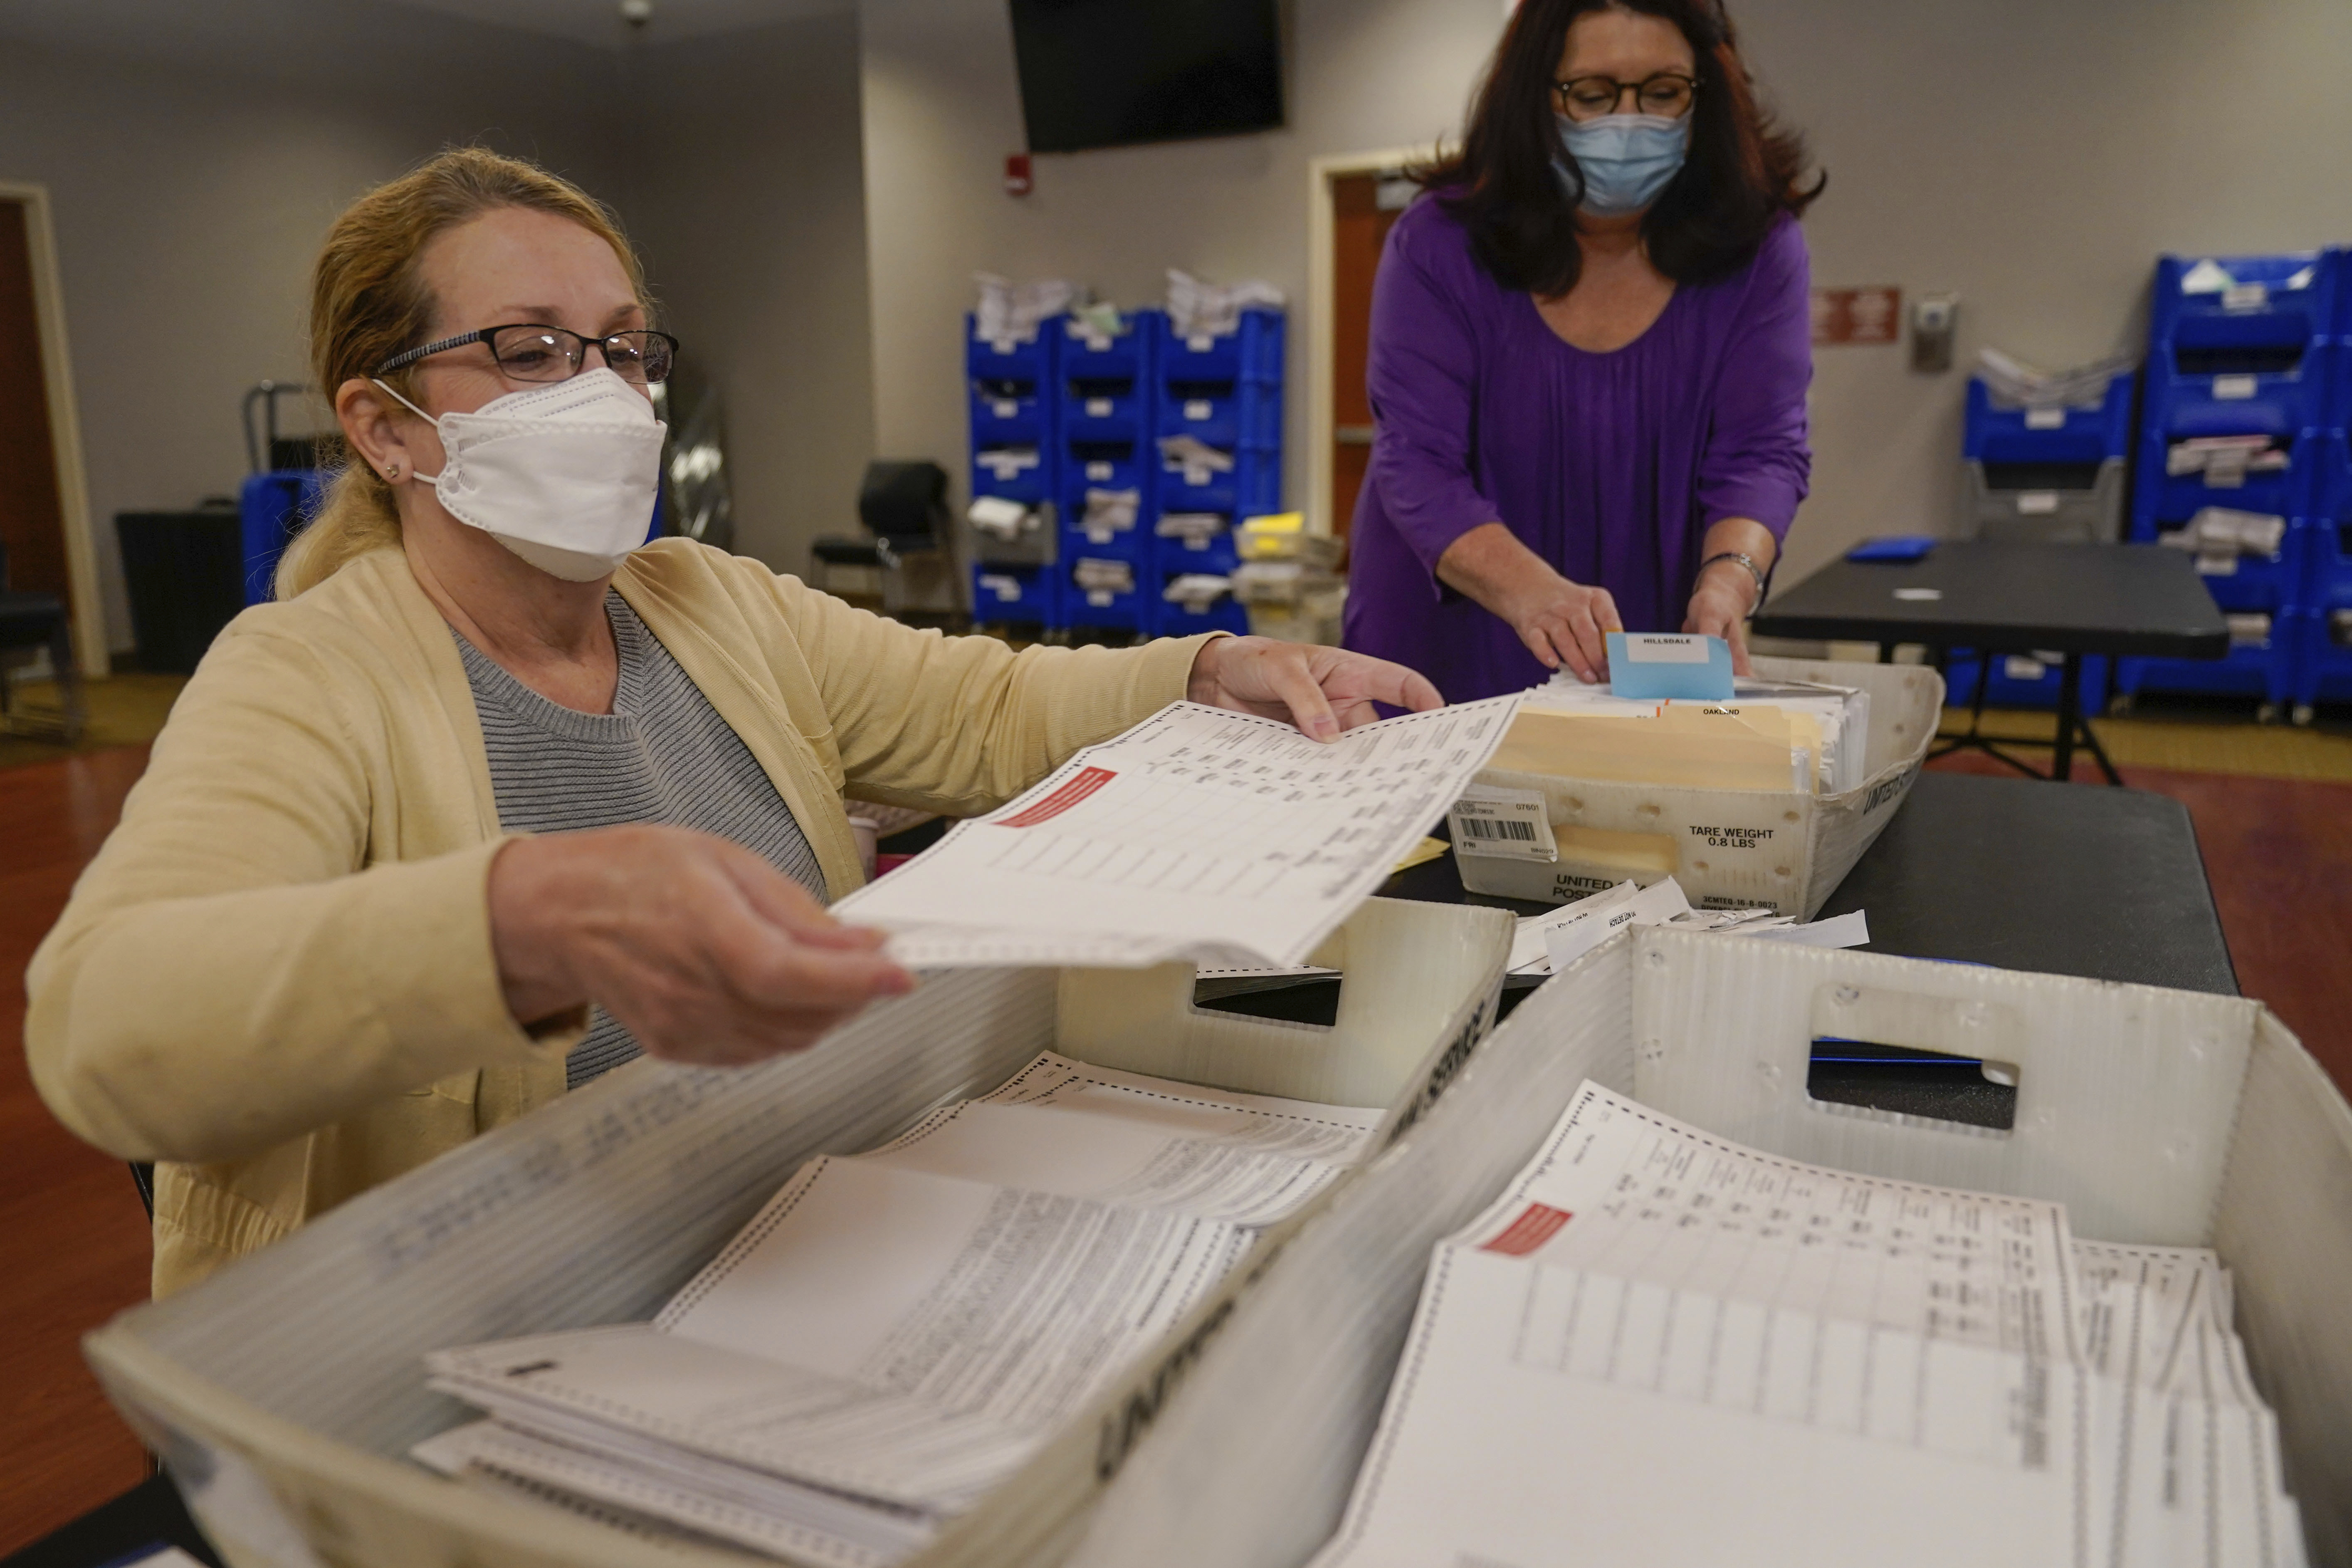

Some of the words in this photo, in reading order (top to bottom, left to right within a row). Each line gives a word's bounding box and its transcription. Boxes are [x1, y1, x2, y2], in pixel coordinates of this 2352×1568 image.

[1689, 825, 1721, 836] TARE
[1724, 828, 1774, 839] WEIGHT
[1708, 837, 1727, 847] 0.8
[1732, 838, 1756, 848] LBS
[1556, 874, 1613, 890] UNITED
[1553, 886, 1596, 899] POST
[1609, 915, 1624, 928] DETACH
